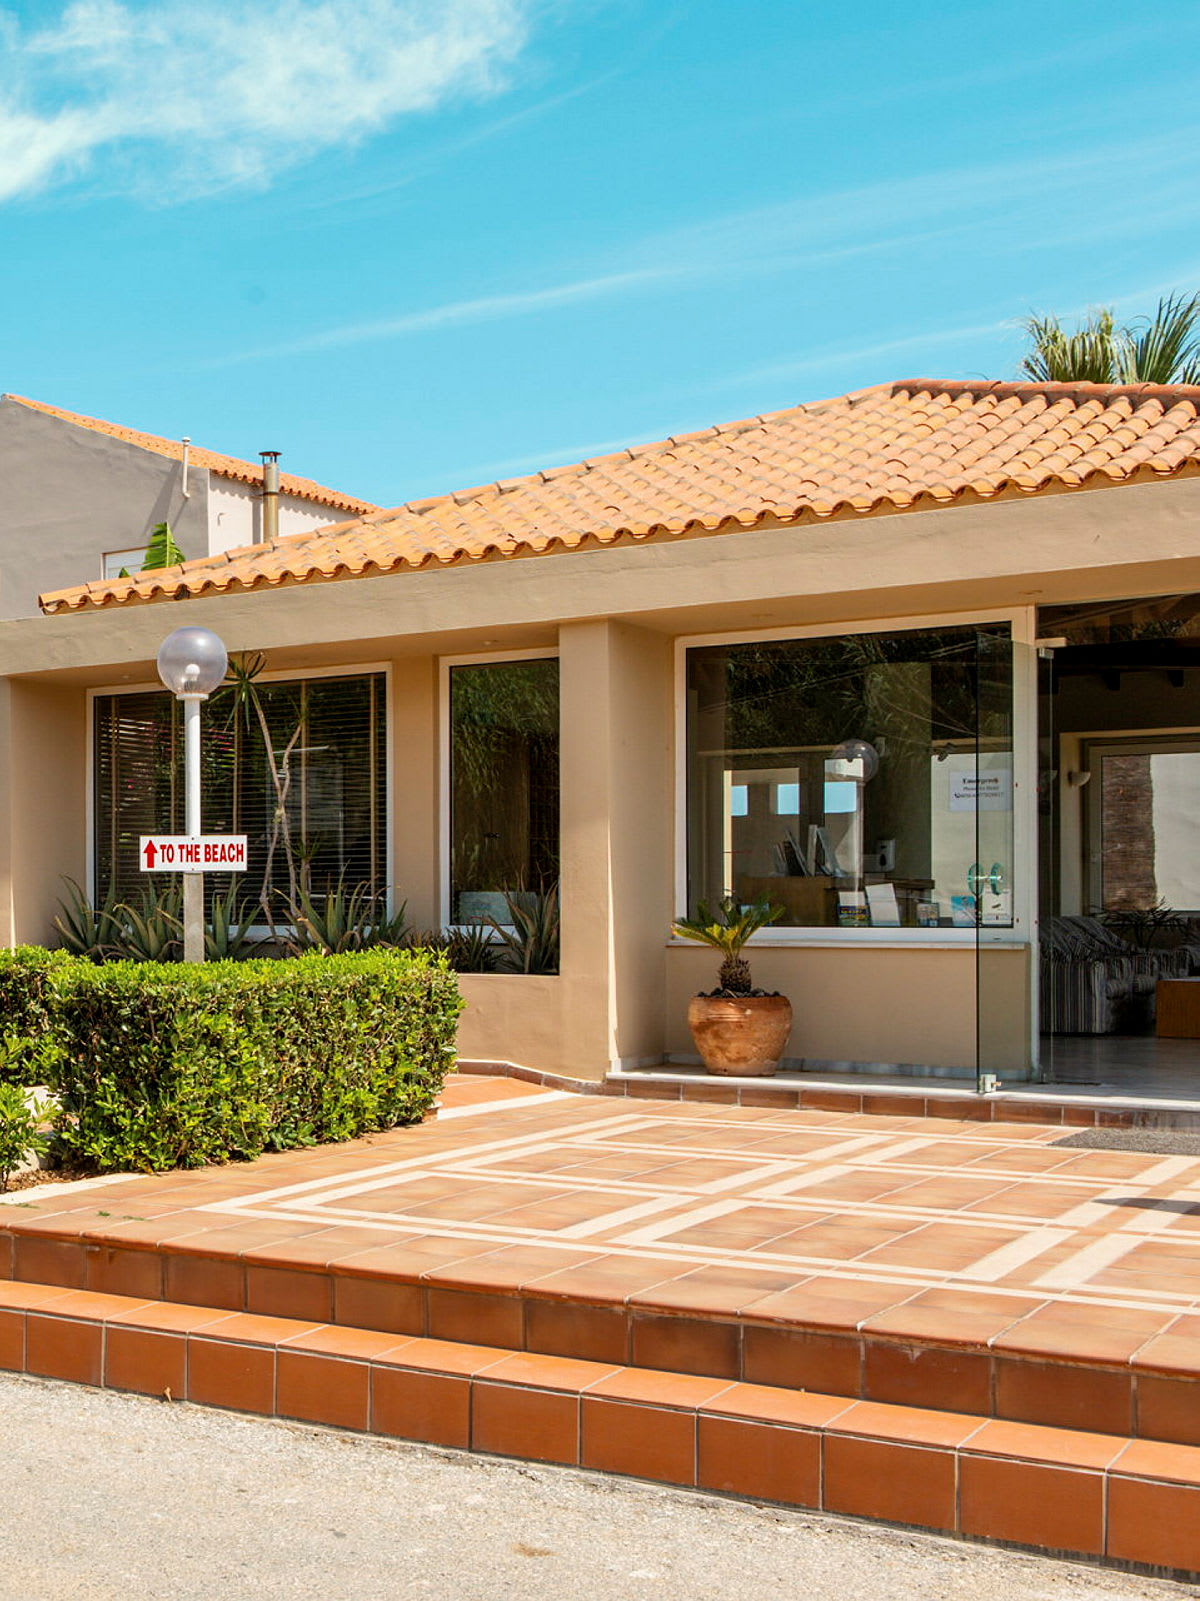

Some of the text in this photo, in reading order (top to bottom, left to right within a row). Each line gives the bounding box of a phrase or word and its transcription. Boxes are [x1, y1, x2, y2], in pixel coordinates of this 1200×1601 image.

[160, 843, 244, 863] TO THE BEACH
